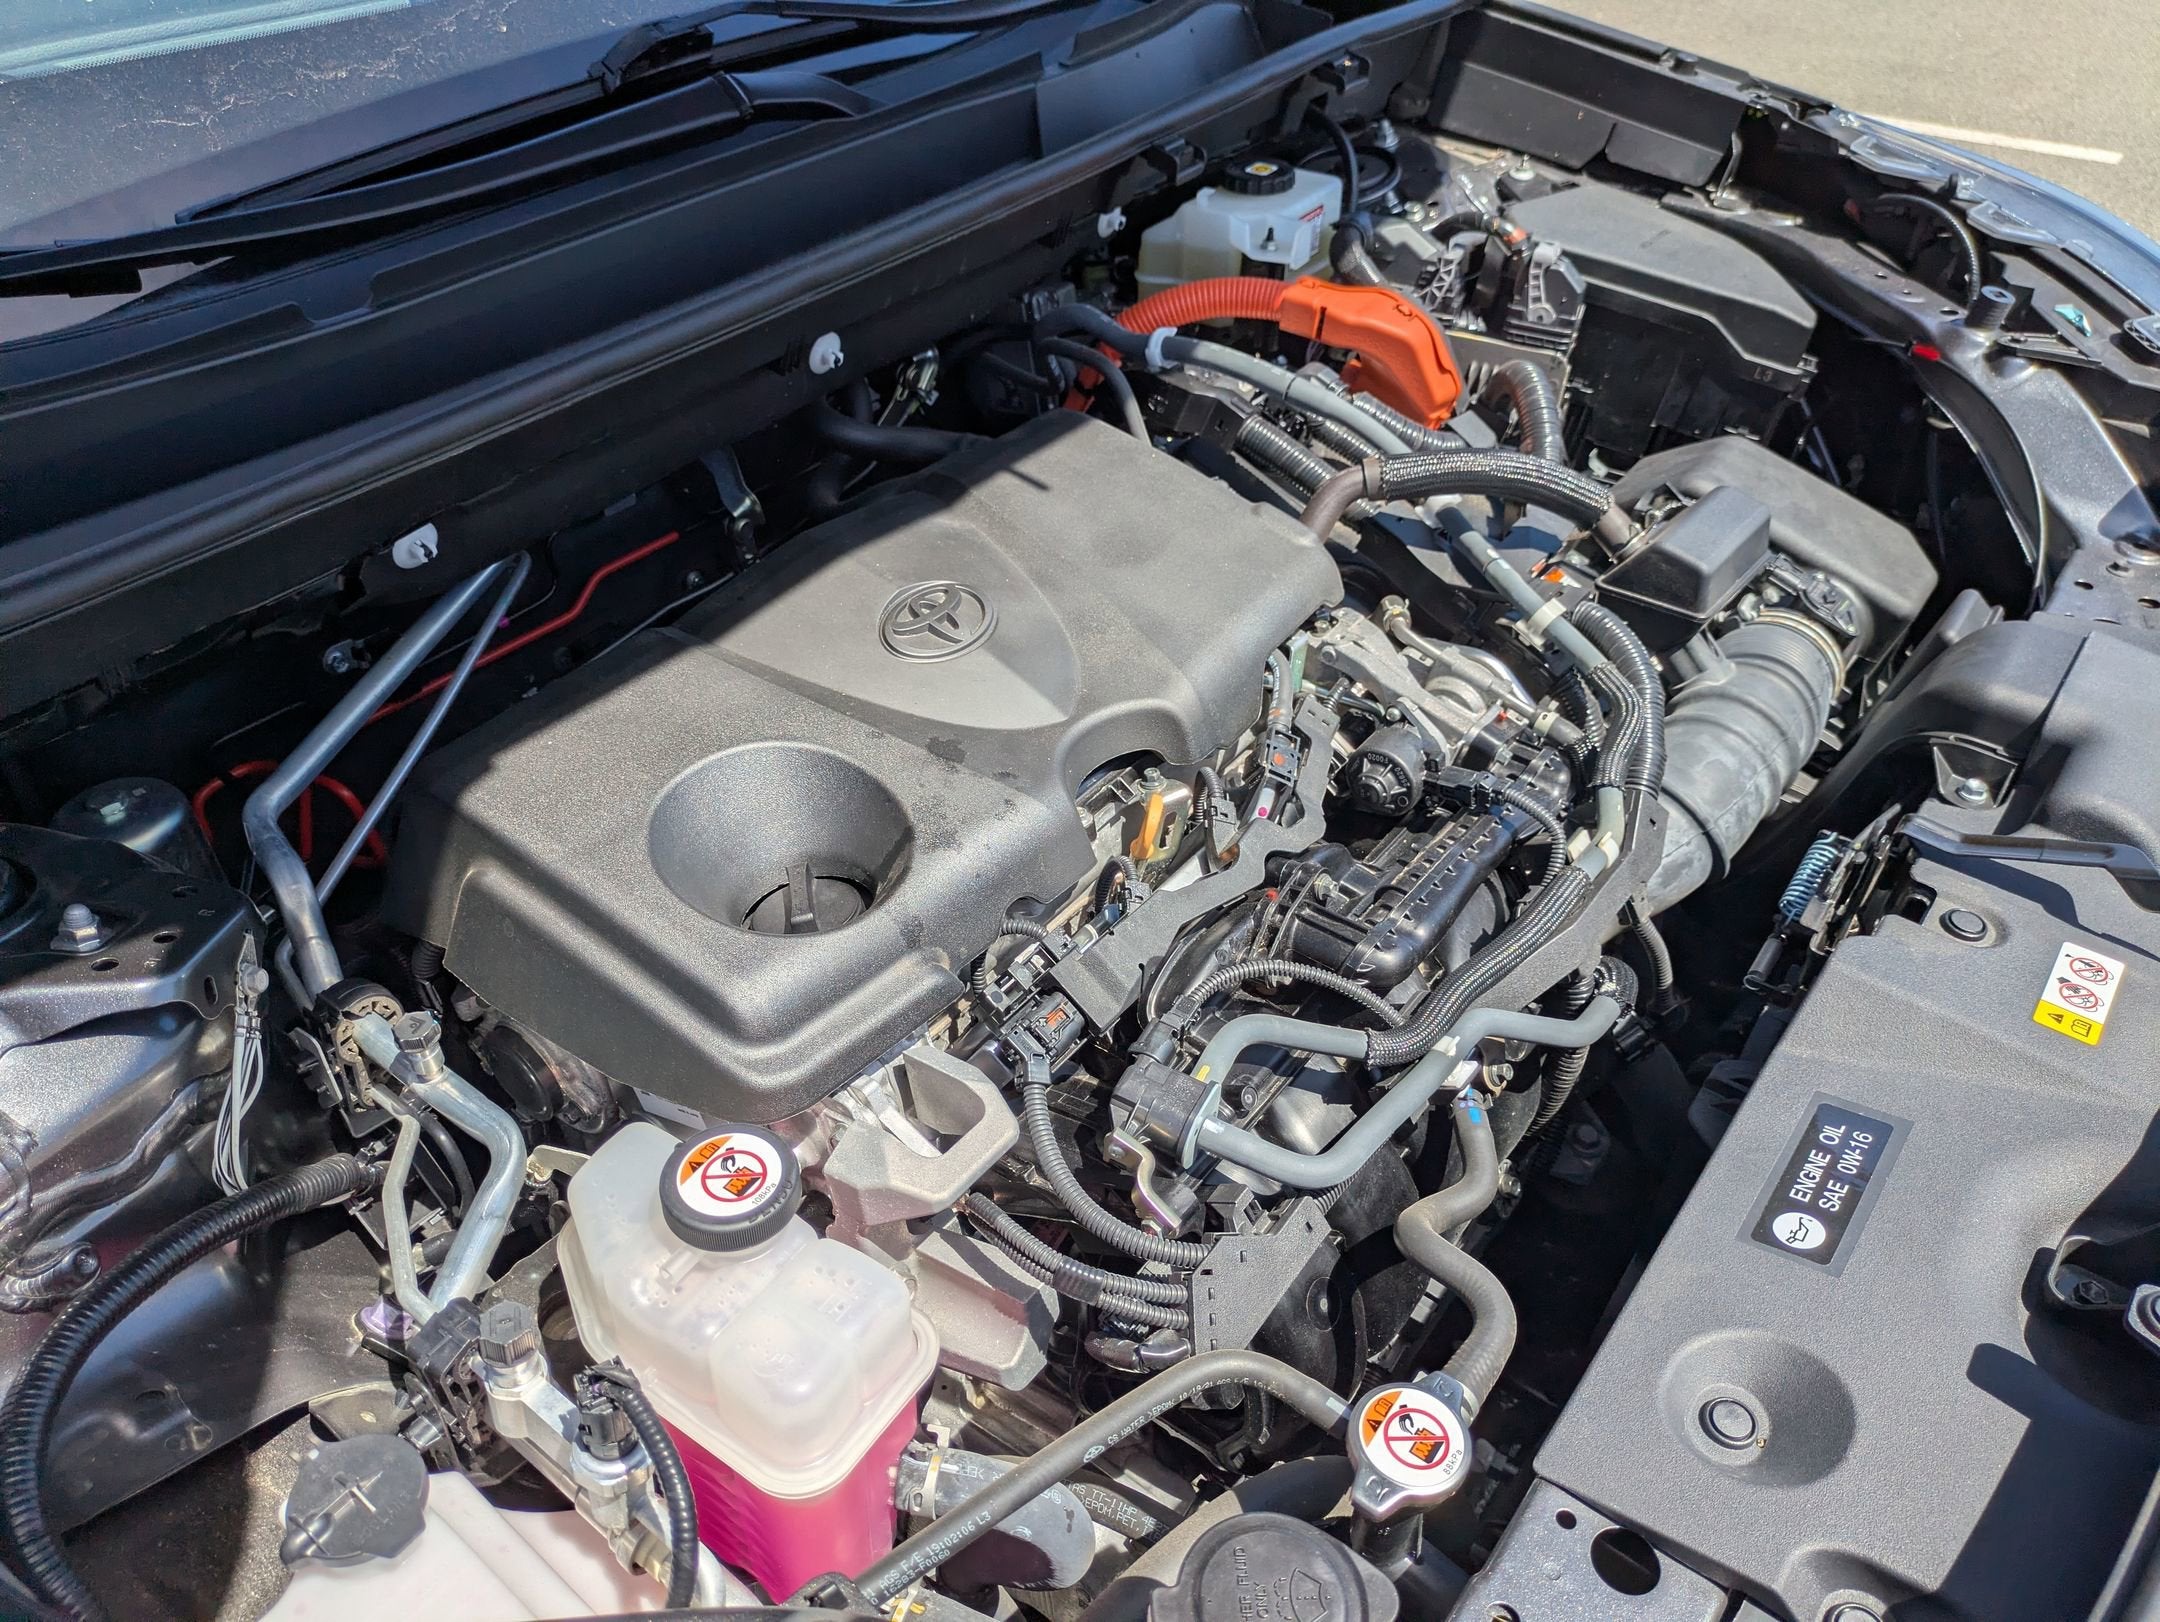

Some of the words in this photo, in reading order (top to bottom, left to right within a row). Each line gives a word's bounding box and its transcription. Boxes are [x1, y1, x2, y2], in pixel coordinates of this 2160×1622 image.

[1789, 1149, 1831, 1203] ENGINE
[1818, 1124, 1846, 1146] OIL
[1818, 1180, 1849, 1212] SAE
[1837, 1131, 1873, 1175] 0W-16
[752, 1182, 777, 1206] 108kPa
[879, 1568, 901, 1590] AGS
[925, 1520, 976, 1557] 19:02:06
[975, 1510, 992, 1525] L3
[883, 1548, 951, 1598] 16283-F0060
[1233, 1546, 1250, 1586] FLUID
[1253, 1581, 1269, 1619] ONLY
